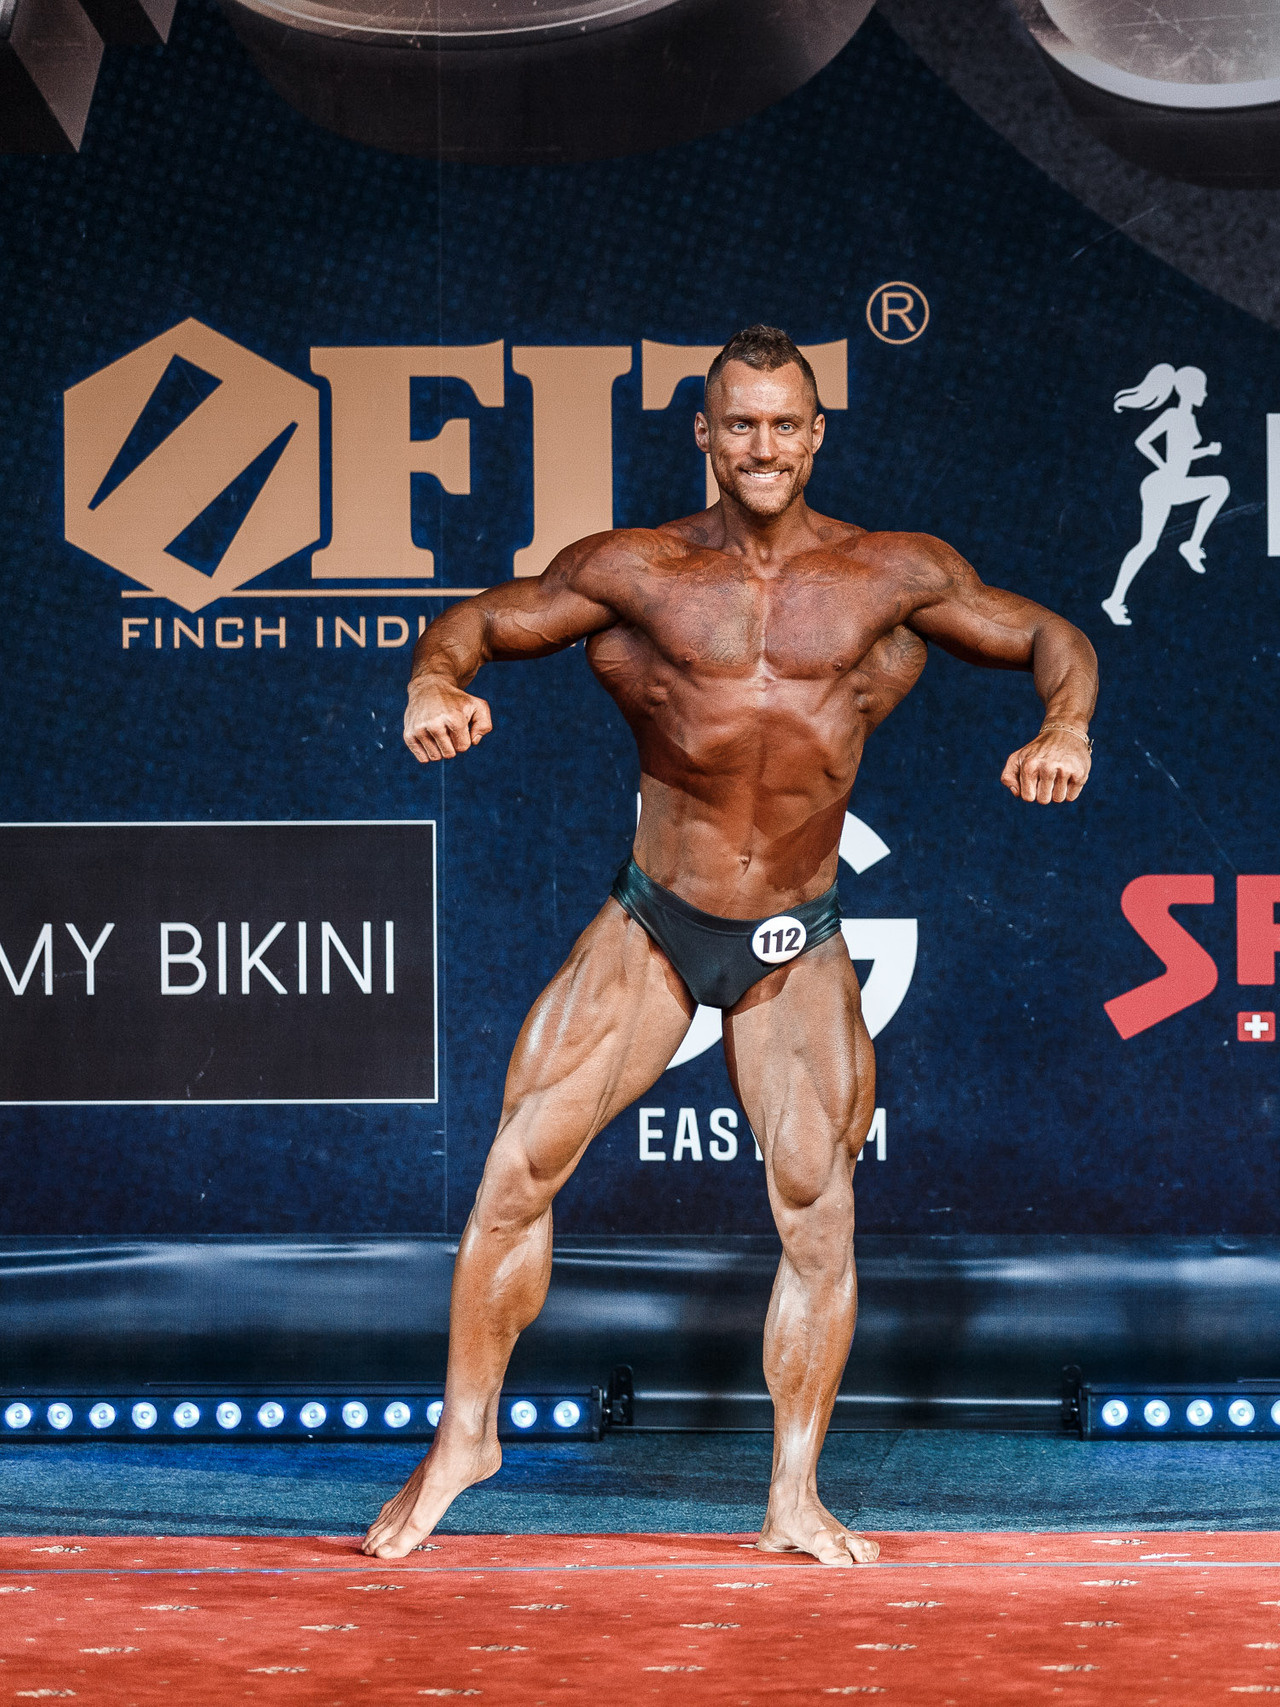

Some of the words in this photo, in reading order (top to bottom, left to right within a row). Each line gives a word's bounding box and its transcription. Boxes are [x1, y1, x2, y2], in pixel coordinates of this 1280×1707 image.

[121, 616, 287, 649] FINCH
[759, 927, 801, 954] 112
[160, 920, 395, 996] BIKINI
